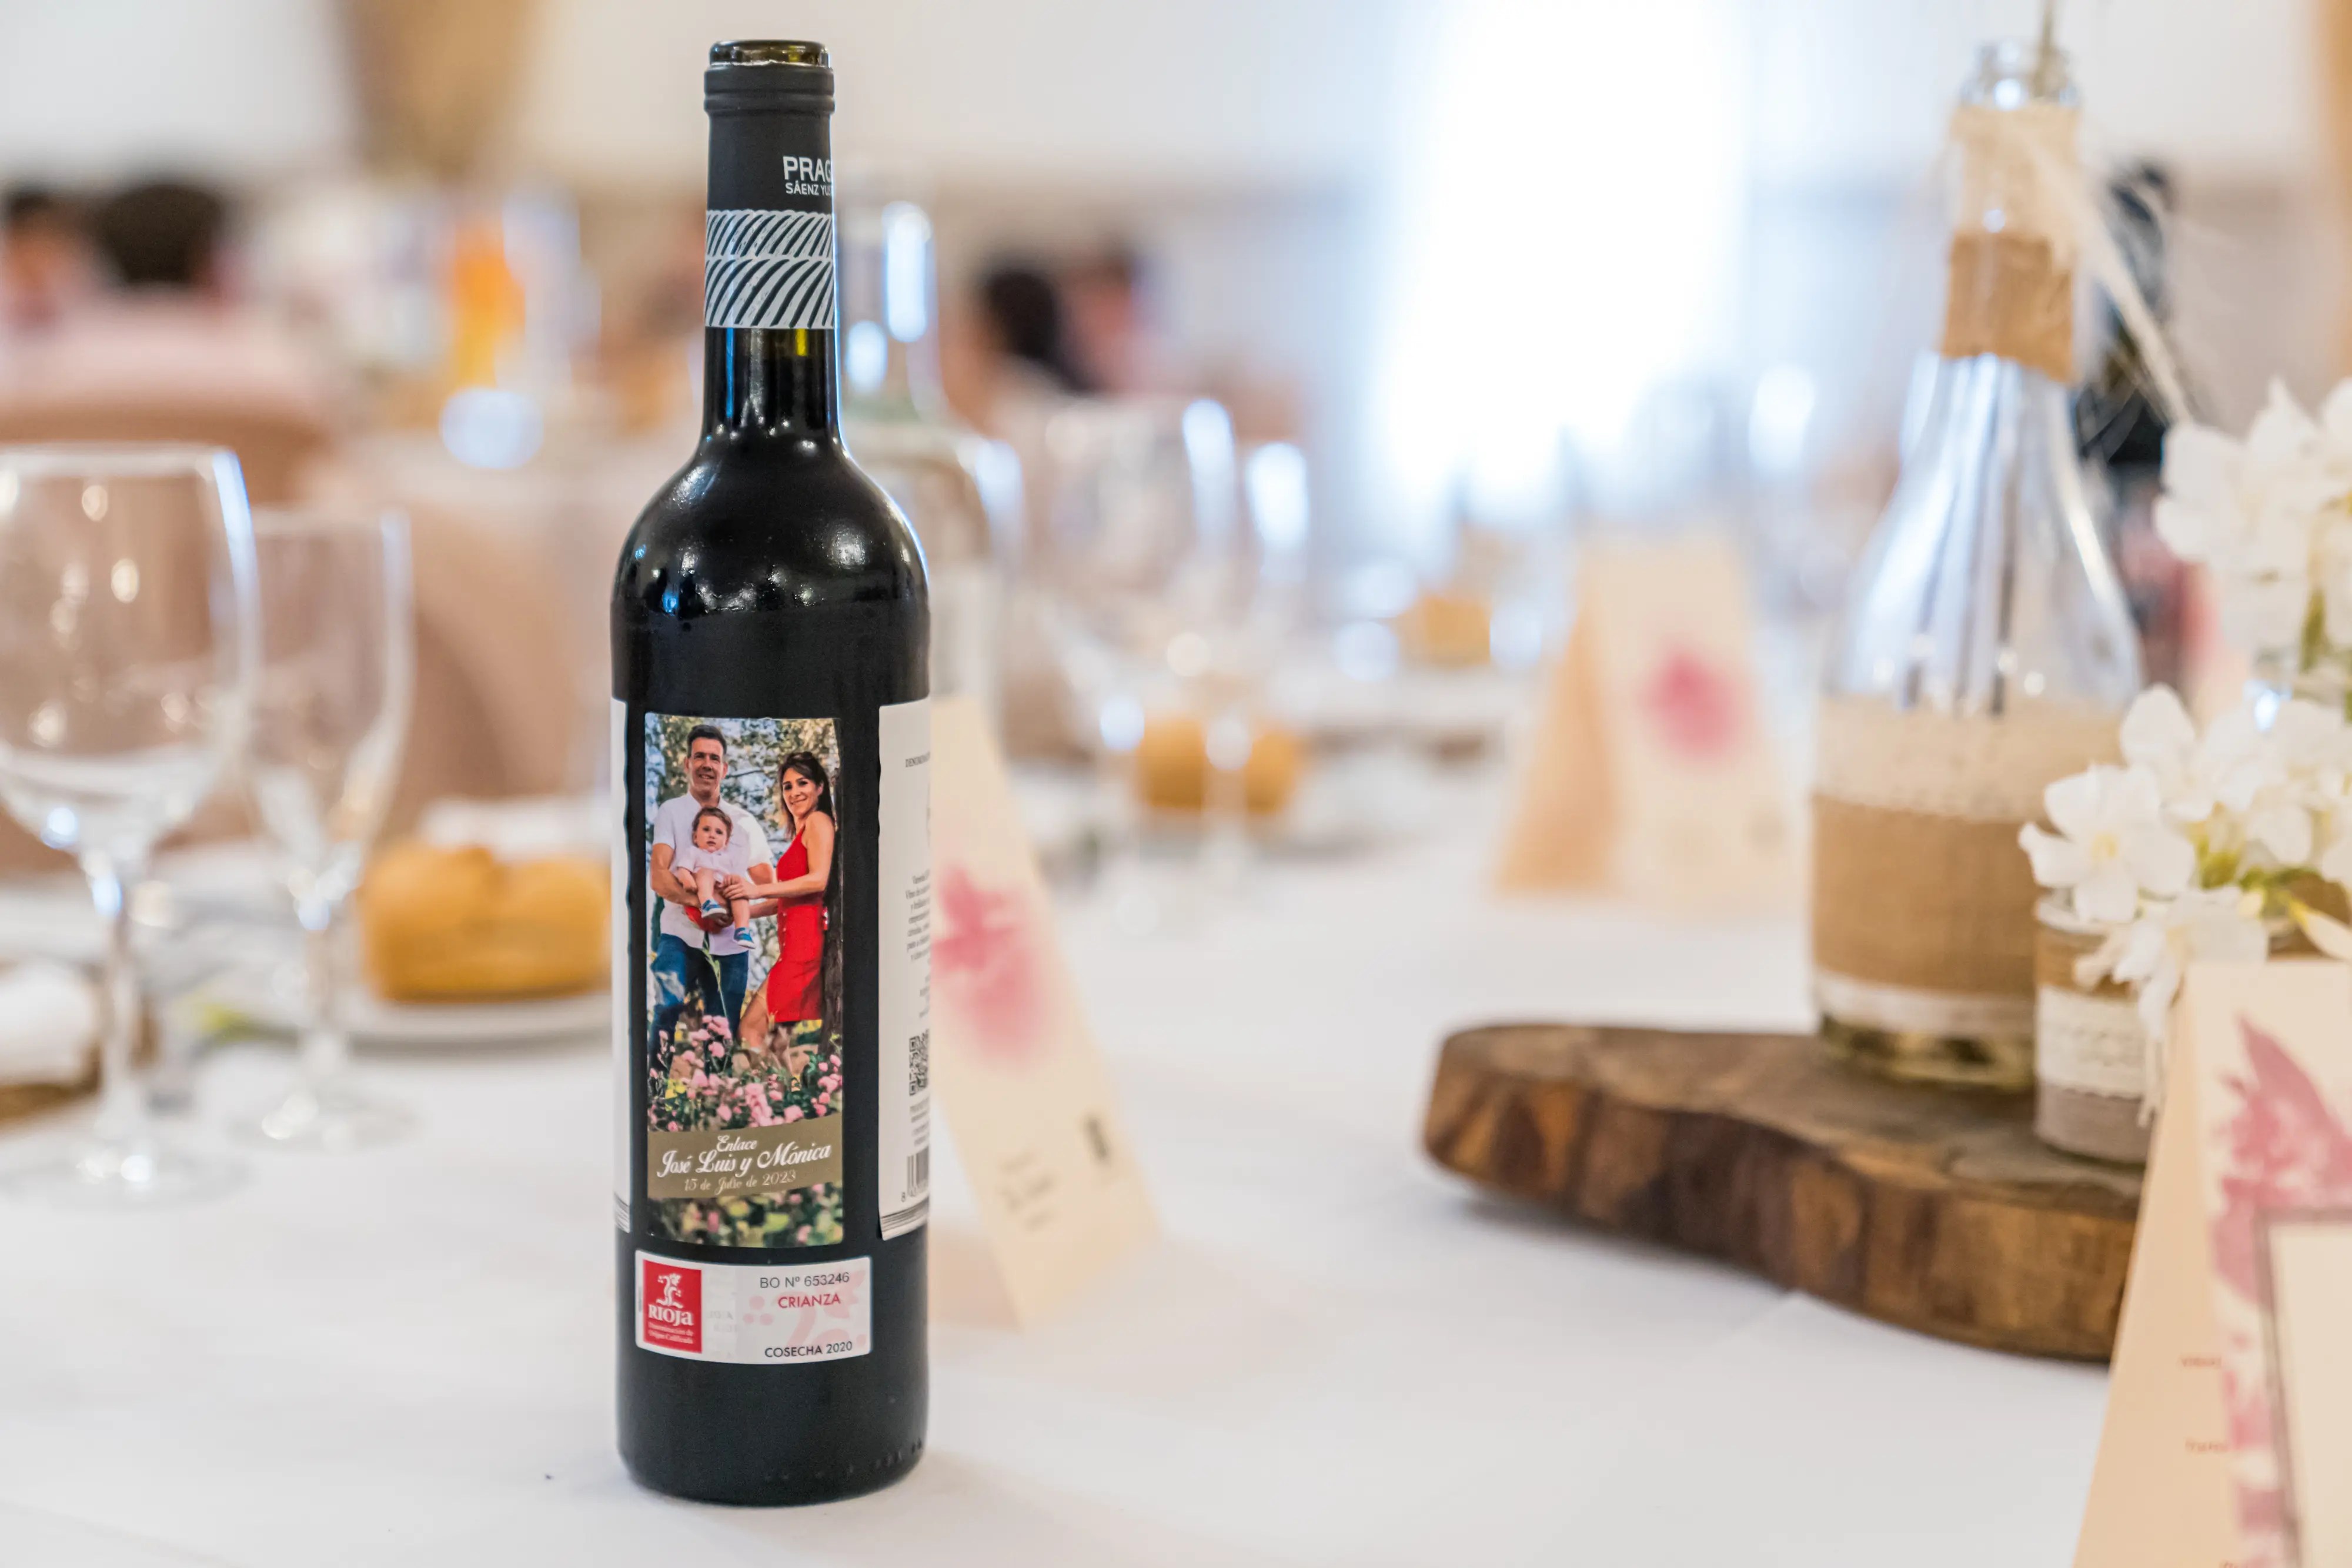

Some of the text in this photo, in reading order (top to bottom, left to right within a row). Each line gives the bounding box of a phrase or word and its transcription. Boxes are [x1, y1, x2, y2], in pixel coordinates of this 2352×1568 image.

[785, 180, 819, 196] SÁENZ
[716, 1135, 758, 1152] Enlace
[656, 1141, 832, 1178] José Luis y Mónica
[684, 1169, 797, 1195] 15 de Julio de 2023
[760, 1277, 780, 1289] BO
[804, 1272, 850, 1287] 653246
[777, 1293, 841, 1309] CRIANZA
[764, 1340, 853, 1358] COSECHA 2020
